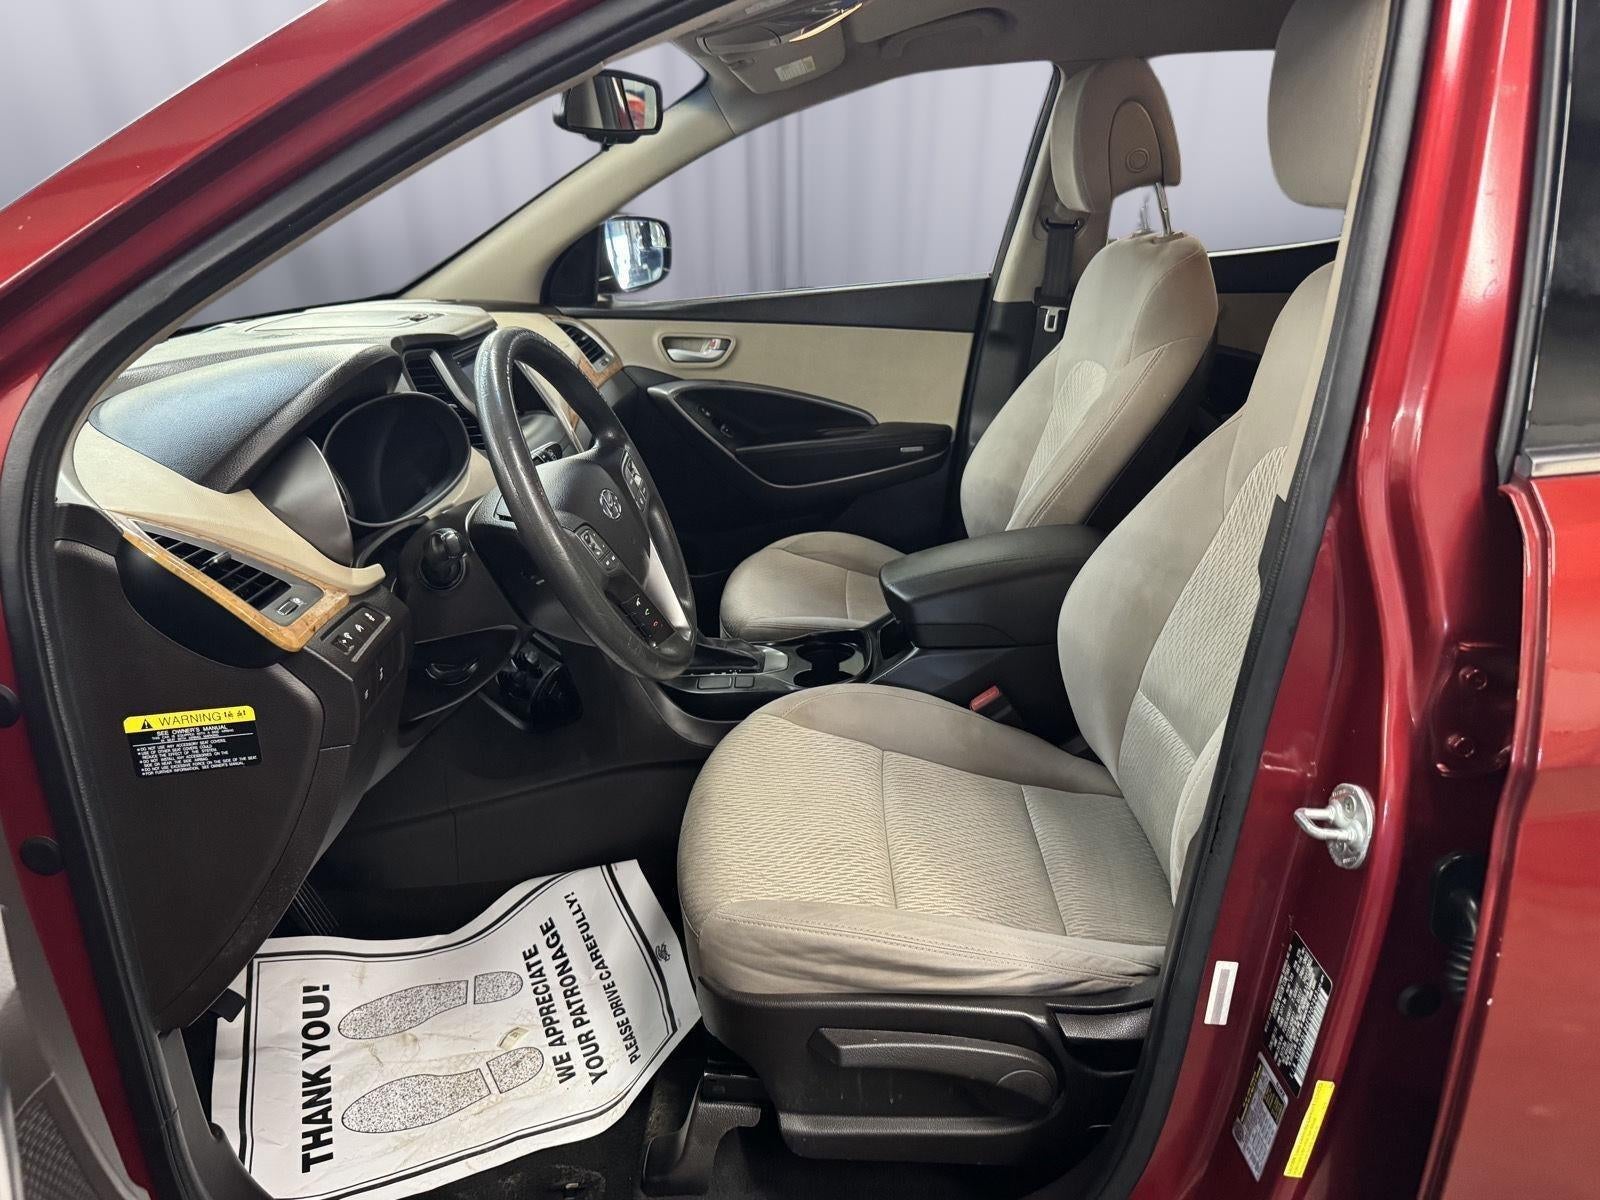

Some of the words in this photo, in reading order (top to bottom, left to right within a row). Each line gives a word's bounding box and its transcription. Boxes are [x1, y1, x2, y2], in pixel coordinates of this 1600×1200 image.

[158, 711, 221, 726] WARNING
[564, 892, 612, 980] CAREFULLY!
[523, 944, 566, 1046] APPRECIATE
[540, 917, 590, 1028] PATRONAGE
[603, 980, 626, 1018] DRIVE
[302, 985, 330, 1061] YOU!
[617, 1017, 641, 1064] PLEASE
[552, 1051, 576, 1084] WE
[578, 1029, 608, 1084] YOUR
[302, 1065, 333, 1173] THANK
